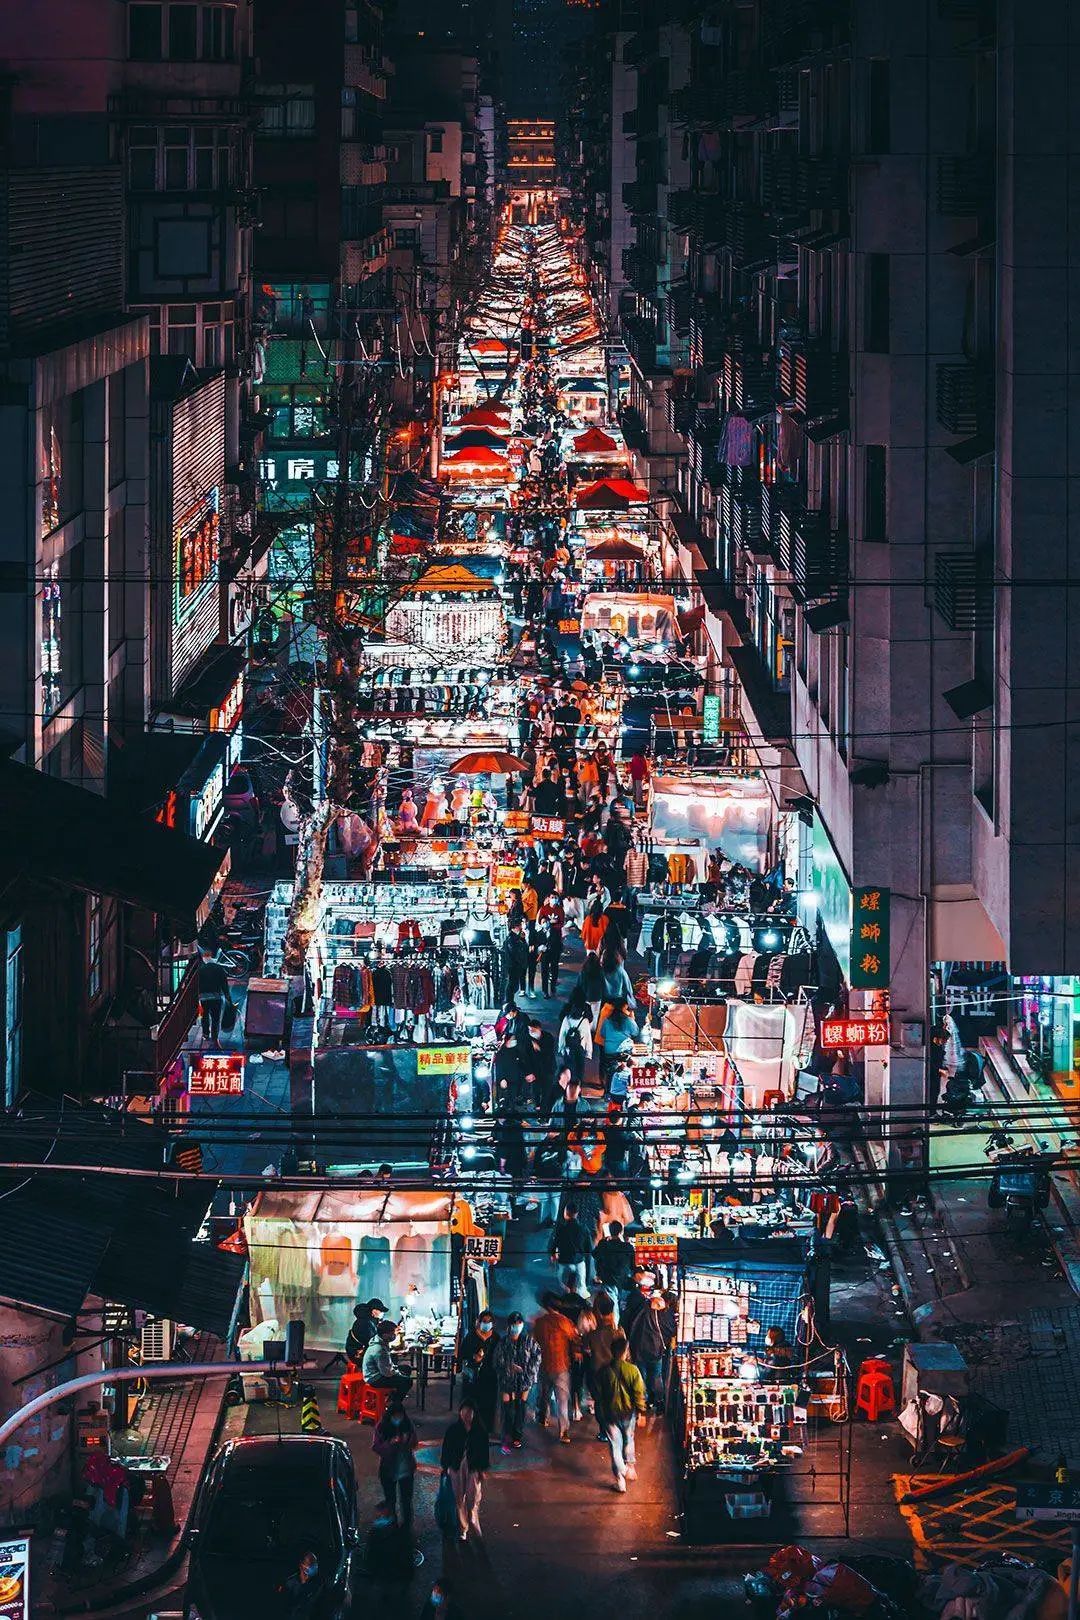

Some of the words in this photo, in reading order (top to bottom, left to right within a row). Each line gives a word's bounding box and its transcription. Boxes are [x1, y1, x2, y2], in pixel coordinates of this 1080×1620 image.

[825, 1023, 887, 1043] 螺蛳粉
[190, 1071, 241, 1093] 兰州拉面
[465, 1238, 499, 1257] 贴膜
[1026, 1509, 1034, 1517] N
